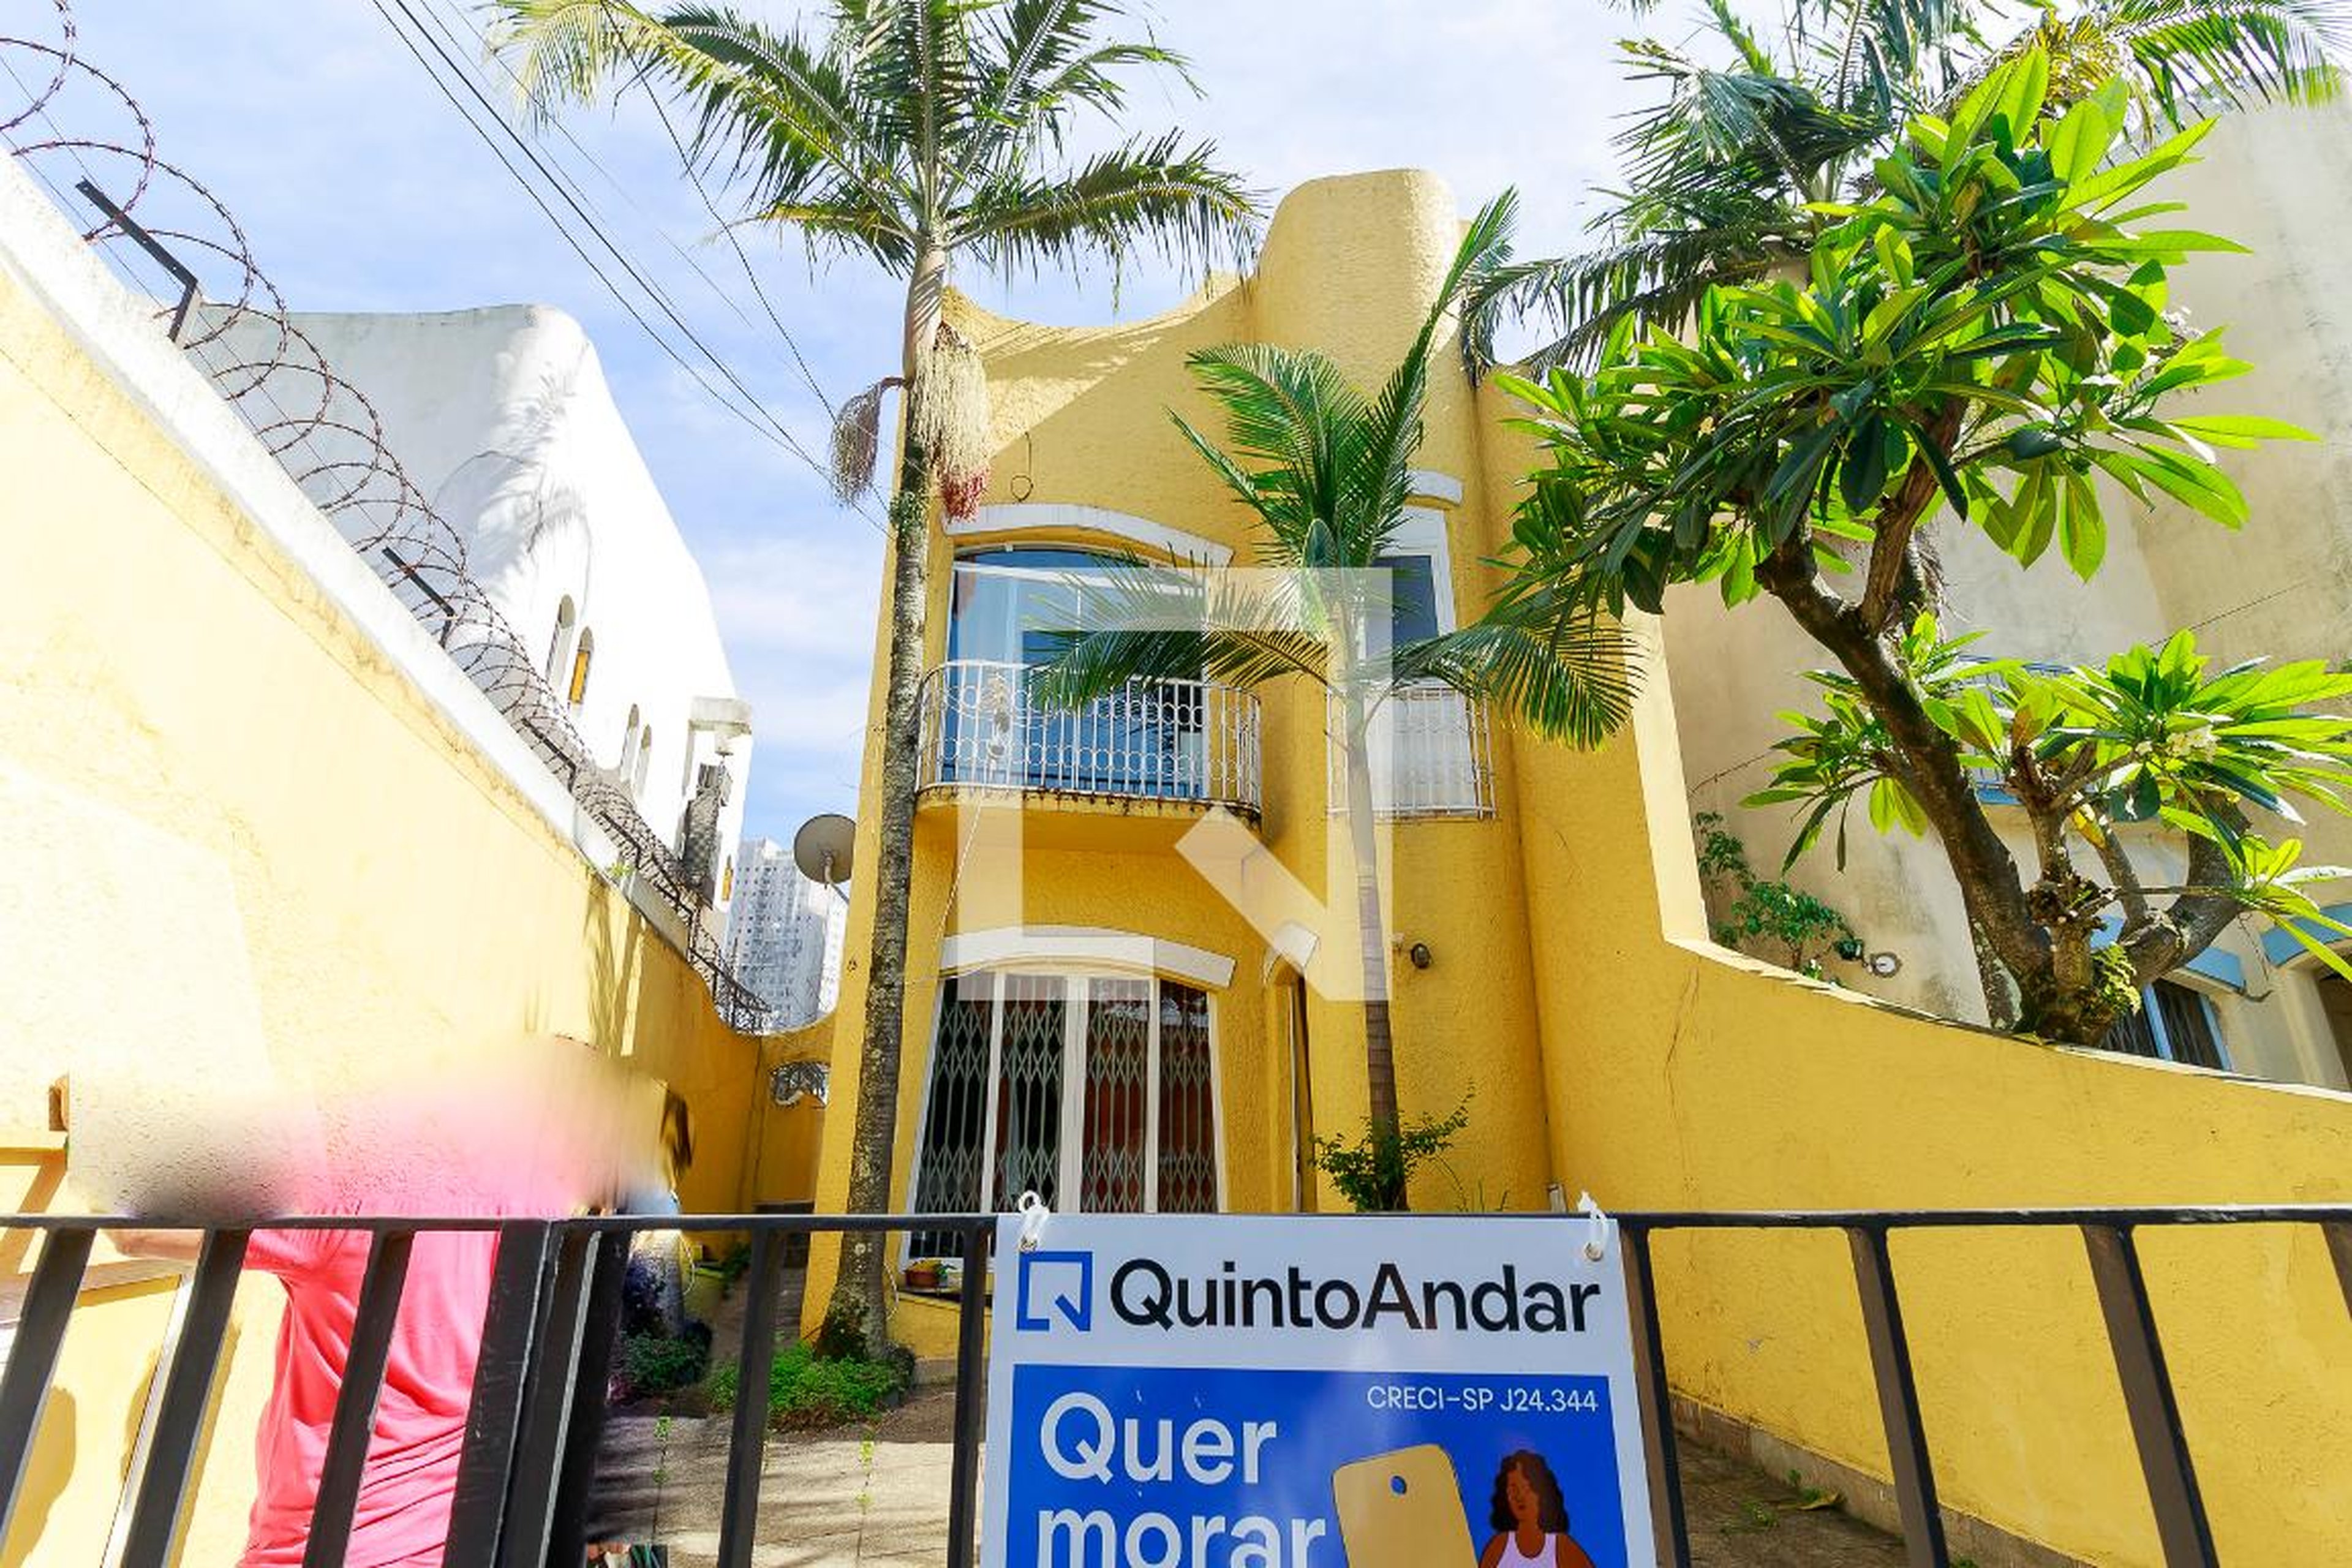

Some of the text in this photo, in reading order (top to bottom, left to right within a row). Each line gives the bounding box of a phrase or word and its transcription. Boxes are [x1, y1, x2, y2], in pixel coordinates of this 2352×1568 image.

[1110, 1258, 1600, 1333] QuintoAndar
[1366, 1385, 1598, 1412] CRECI-SP J24.344
[1039, 1391, 1277, 1485] Quer
[1037, 1507, 1327, 1568] morar
